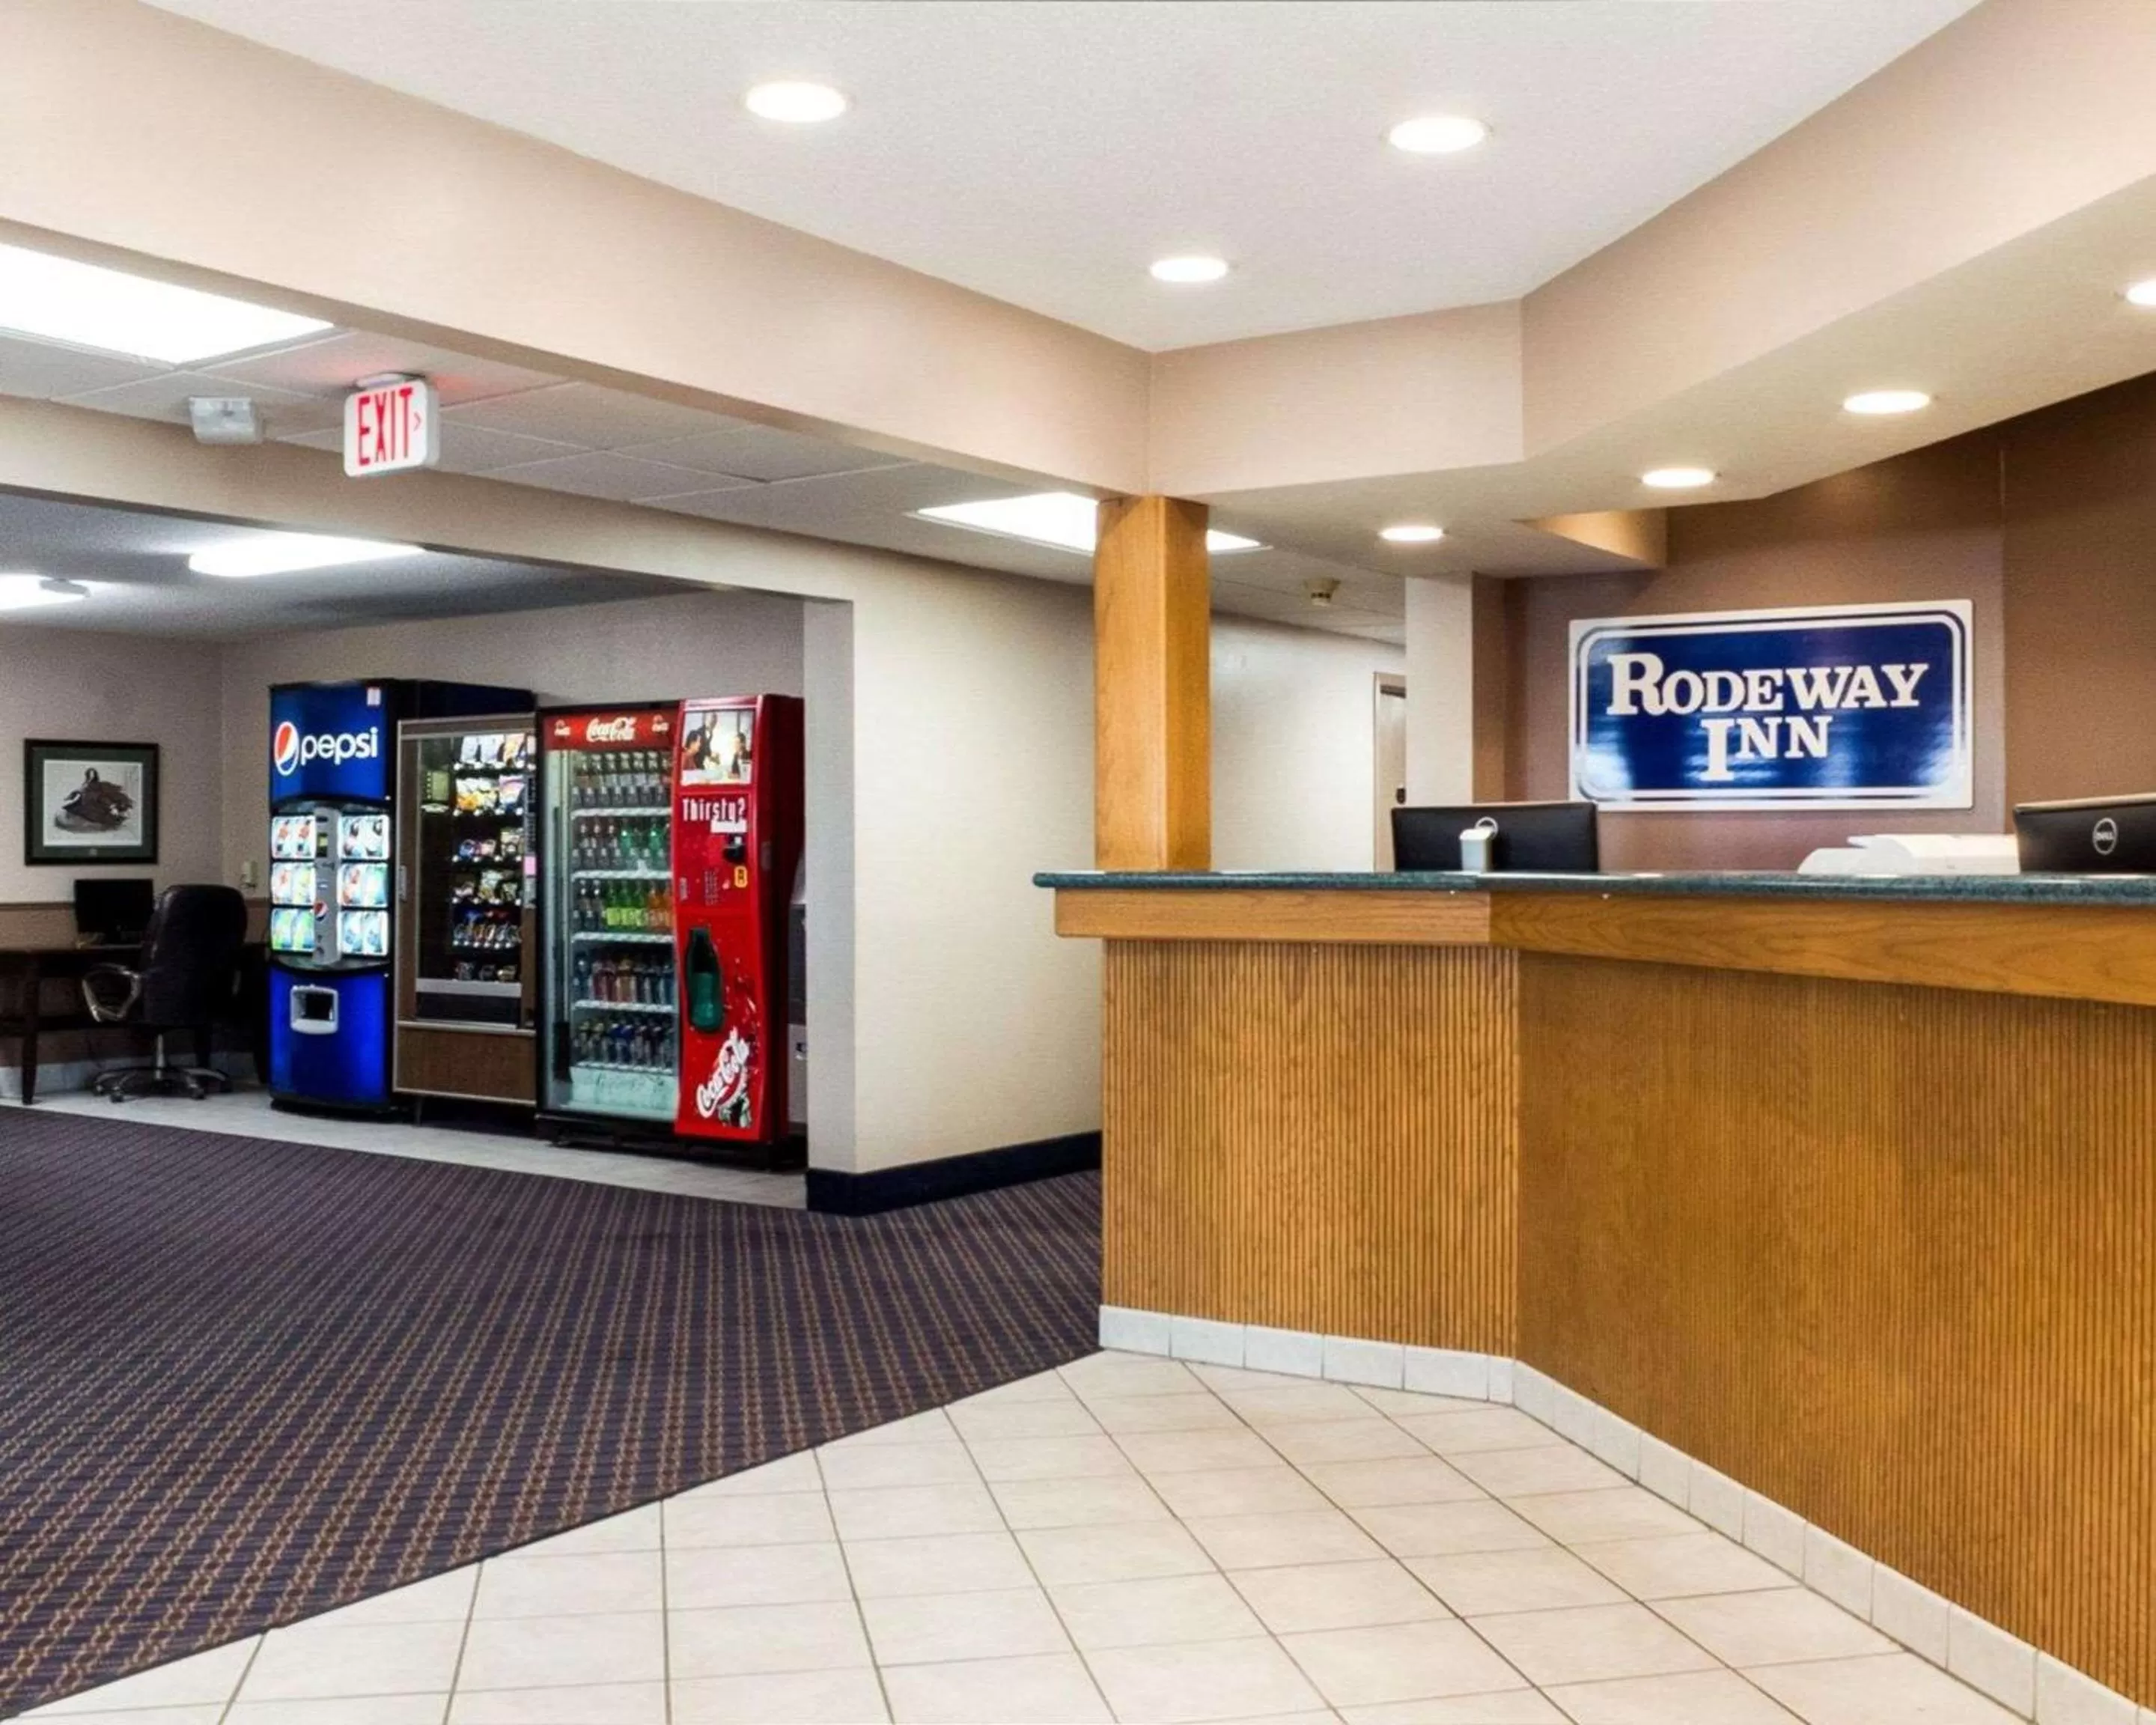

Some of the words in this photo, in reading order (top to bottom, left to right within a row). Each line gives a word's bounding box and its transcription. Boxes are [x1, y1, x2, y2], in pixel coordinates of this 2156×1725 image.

[357, 387, 413, 466] EXIT
[1606, 652, 1929, 717] RODEWAY
[301, 727, 378, 766] pepsi
[586, 717, 637, 743] Coca-Cola
[1699, 716, 1833, 782] INN
[682, 797, 746, 823] Thirsty?
[696, 1024, 749, 1119] Coca-Cola
